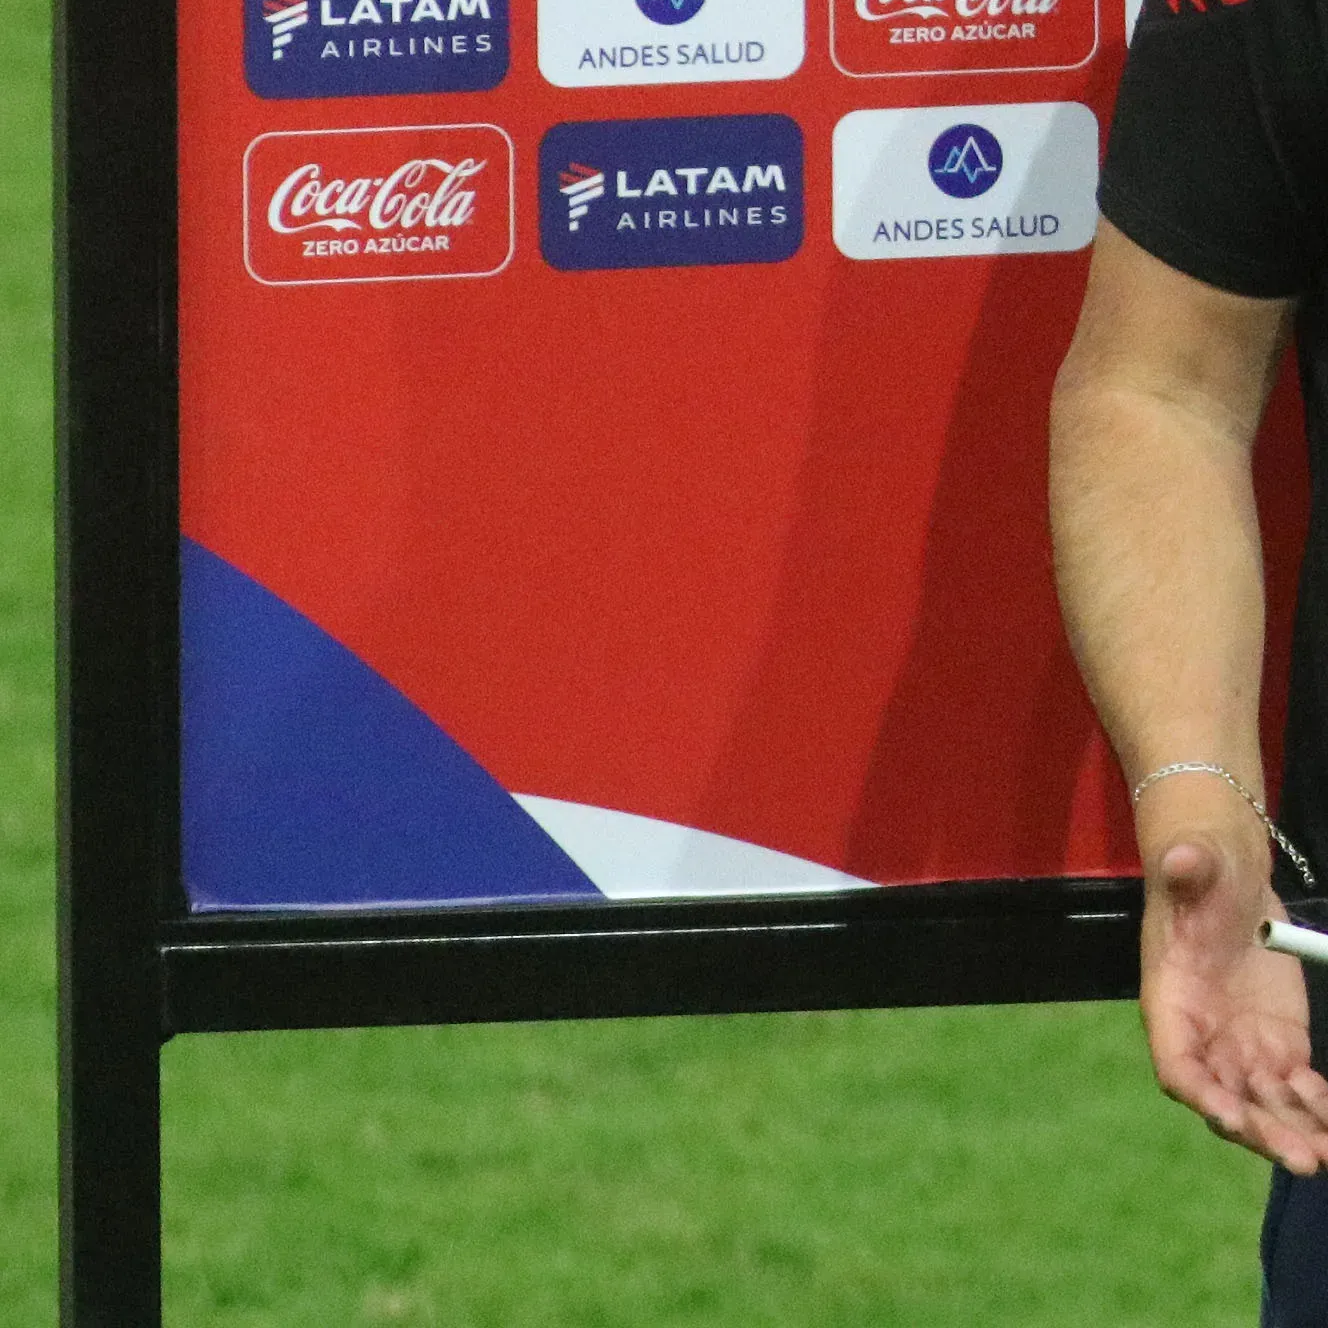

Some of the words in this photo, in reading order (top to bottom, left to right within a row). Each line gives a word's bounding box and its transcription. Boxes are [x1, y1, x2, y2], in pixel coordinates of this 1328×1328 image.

[321, 34, 491, 58] AIRLINES
[890, 26, 946, 44] ZERO
[951, 23, 1035, 41] AZÚCAR
[579, 45, 670, 69] ANDES
[677, 41, 765, 65] SALUD
[617, 165, 785, 197] LATAM
[268, 158, 487, 234] Coca-Cola
[617, 206, 787, 230] AIRLINES
[874, 218, 964, 241] ANDES
[972, 213, 1062, 239] SALUD
[303, 239, 359, 257] ZERO
[364, 234, 449, 253] AZÚCAR
